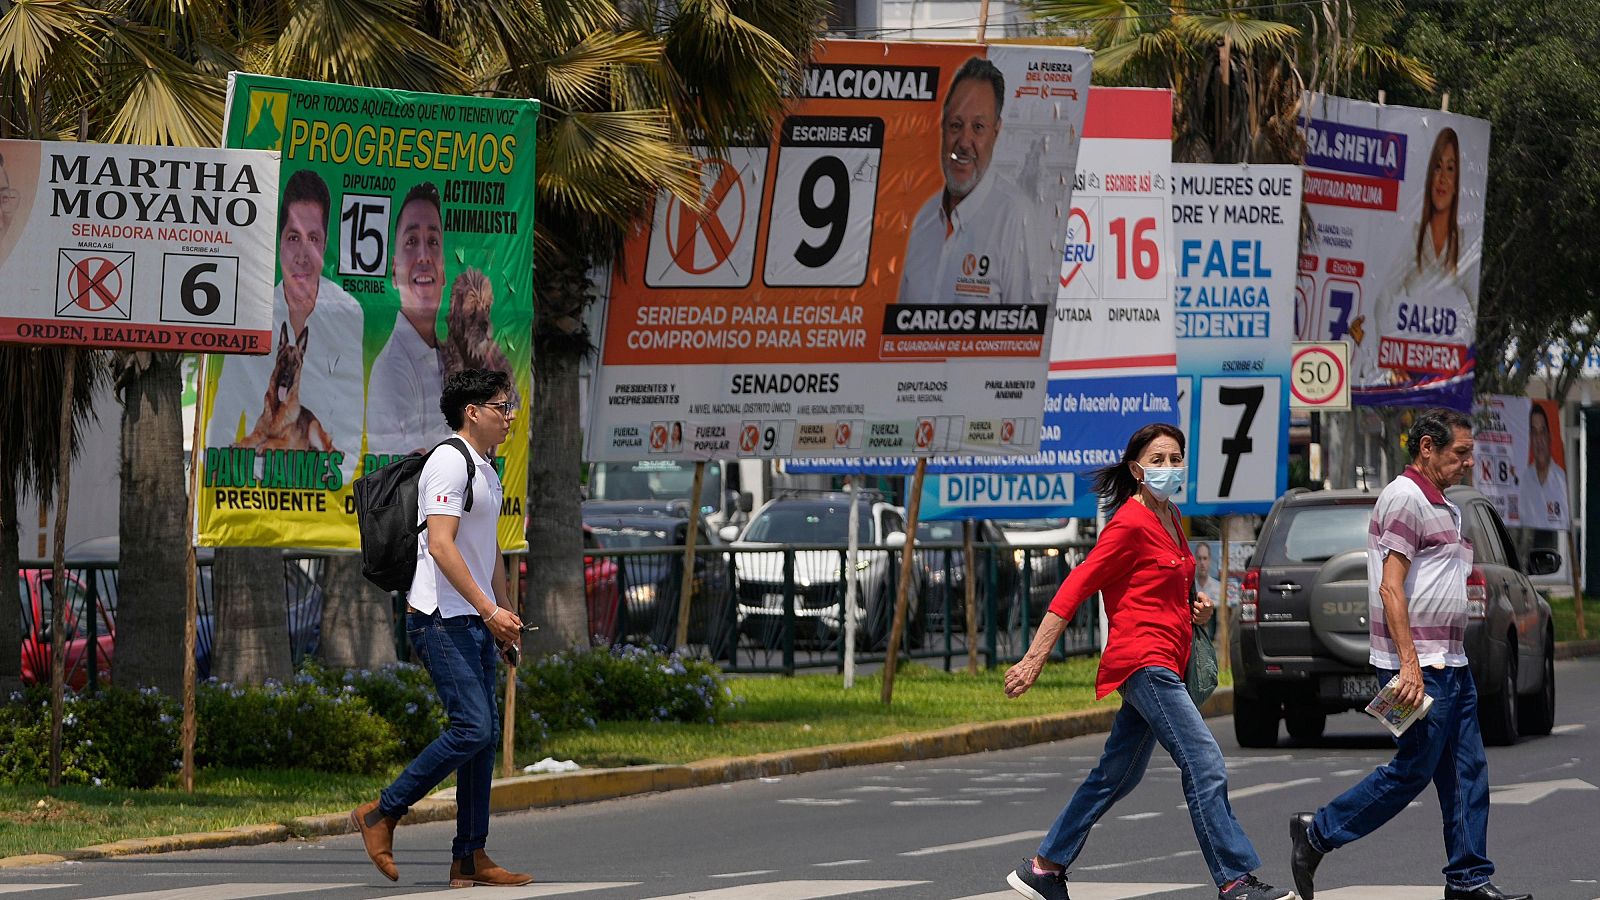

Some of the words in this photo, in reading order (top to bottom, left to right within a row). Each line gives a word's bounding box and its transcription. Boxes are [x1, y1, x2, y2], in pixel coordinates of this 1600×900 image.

[1028, 62, 1038, 70] LA
[1041, 62, 1072, 72] FUERZA
[801, 69, 932, 100] NACIONAL
[1026, 72, 1040, 80] DEL
[1044, 73, 1072, 82] ORDEN
[323, 96, 359, 113] TODOS
[361, 99, 414, 119] AQUELLOS
[417, 105, 438, 121] QUE
[441, 106, 455, 120] NO
[459, 106, 493, 123] TIENEN
[792, 126, 847, 142] ESCRIBE
[849, 123, 872, 142] ASÍ
[288, 119, 517, 175] PROGRESEMOS
[49, 154, 261, 193] MARTHA
[343, 173, 396, 191] DIPUTADO
[1105, 174, 1137, 192] ESCRIBE
[1139, 171, 1151, 192] ASÍ
[444, 179, 505, 205] ACTIVISTA
[1181, 177, 1253, 196] MUJERES
[1259, 177, 1292, 196] QUE
[1304, 178, 1345, 201] DIPUTADA
[1346, 185, 1362, 202] POR
[1363, 187, 1382, 204] LIMA
[50, 188, 257, 226] MOYANO
[666, 158, 745, 274] K
[794, 156, 849, 269] 9
[1173, 205, 1203, 224] DRE
[1210, 205, 1218, 223] Y
[1225, 205, 1284, 225] MADRE.
[445, 209, 517, 234] ANIMALISTA
[1317, 223, 1339, 234] ALIANZA
[72, 223, 153, 239] SENADORA
[158, 227, 232, 244] NACIONAL
[342, 201, 385, 273] 15
[1323, 236, 1352, 248] PROGRESO
[1064, 244, 1094, 262] ERU
[1109, 217, 1160, 280] 16
[978, 255, 989, 276] 9
[1181, 239, 1272, 278] FAEL
[1333, 261, 1356, 273] Escribe
[68, 257, 122, 311] K
[181, 263, 221, 316] 6
[343, 279, 385, 294] ESCRIBE
[1196, 286, 1270, 307] ALIAGA
[637, 306, 727, 324] SERIEDAD
[731, 306, 778, 324] PARA
[782, 306, 863, 324] LEGISLAR
[896, 309, 975, 331] CARLOS
[979, 305, 1038, 330] MESÍA
[1055, 308, 1092, 321] PUTADA
[1108, 308, 1160, 322] DIPUTADA
[1329, 289, 1353, 340] 7
[1398, 303, 1456, 336] SALUD
[1176, 313, 1267, 336] SIDENTE
[17, 324, 87, 341] ORDEN,
[93, 326, 171, 343] LEALTAD
[176, 331, 187, 345] Y
[190, 332, 258, 352] CORAJE
[627, 330, 752, 349] COMPROMISO
[756, 330, 801, 348] PARA
[805, 330, 866, 348] SERVIR
[884, 340, 894, 353] EL
[897, 336, 945, 353] GUARDIÁN
[947, 341, 961, 351] DE
[962, 341, 973, 351] LA
[976, 338, 1040, 351] CONSTITUCIÓN
[1223, 360, 1250, 371] ESCRIBE
[1380, 342, 1404, 366] SIN
[1407, 343, 1461, 370] ESPERA
[1300, 362, 1331, 384] 50
[616, 384, 667, 393] PRESIDENTES
[670, 384, 676, 392] Y
[731, 373, 839, 394] SENADORES
[898, 382, 948, 391] DIPUTADOS
[985, 380, 1035, 389] PARLAMENTO
[609, 395, 679, 405] VICEPRESIDENTES
[918, 394, 943, 402] REGIONAL
[995, 390, 1022, 399] ANDINO
[1064, 393, 1078, 412] de
[1079, 394, 1118, 412] hacerlo
[1121, 398, 1140, 415] por
[1143, 393, 1171, 412] Lima.
[694, 405, 710, 414] NIVEL
[712, 403, 740, 414] NACIONAL
[614, 427, 639, 436] FUERZA
[696, 427, 725, 437] FUERZA
[764, 427, 775, 450] 9
[800, 425, 823, 434] FUERZA
[871, 424, 899, 434] FUERZA
[969, 432, 994, 440] POPULAR
[613, 438, 642, 446] POPULAR
[694, 440, 729, 451] POPULAR
[798, 435, 826, 444] POPULAR
[869, 438, 902, 447] POPULAR
[1218, 385, 1264, 497] 7
[1058, 451, 1080, 464] MAS
[1083, 450, 1115, 464] CERCA
[205, 447, 256, 487] PAUL
[261, 448, 345, 491] JAIMES
[1499, 462, 1508, 482] 8
[947, 475, 1067, 502] DIPUTADA
[216, 490, 326, 512] PRESIDENTE
[500, 497, 521, 516] MA
[1554, 501, 1560, 515] 8
[1322, 601, 1367, 615] SUZ
